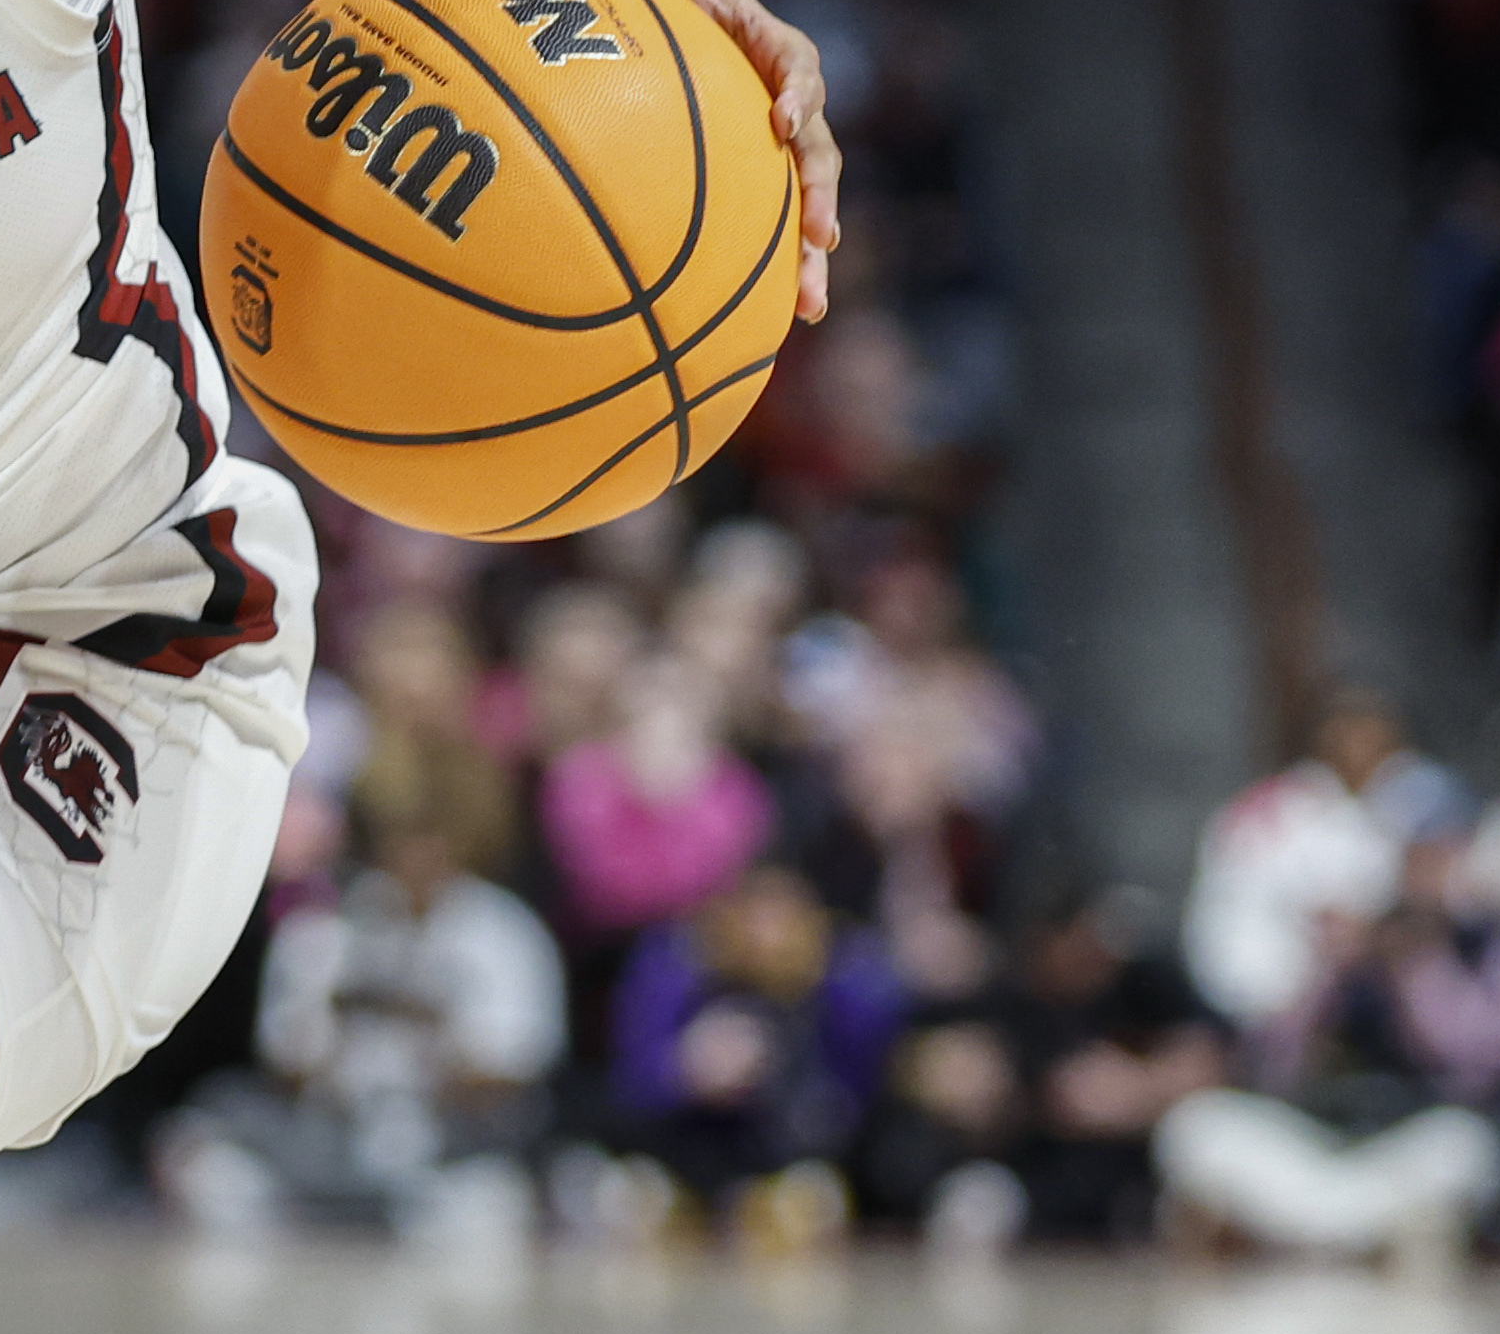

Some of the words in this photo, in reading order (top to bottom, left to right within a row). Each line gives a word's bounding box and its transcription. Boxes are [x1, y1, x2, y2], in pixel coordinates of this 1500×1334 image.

[340, 2, 362, 23] BALL
[360, 18, 395, 46] GAME
[394, 45, 449, 87] INDOOR
[264, 7, 501, 245] Wilson
